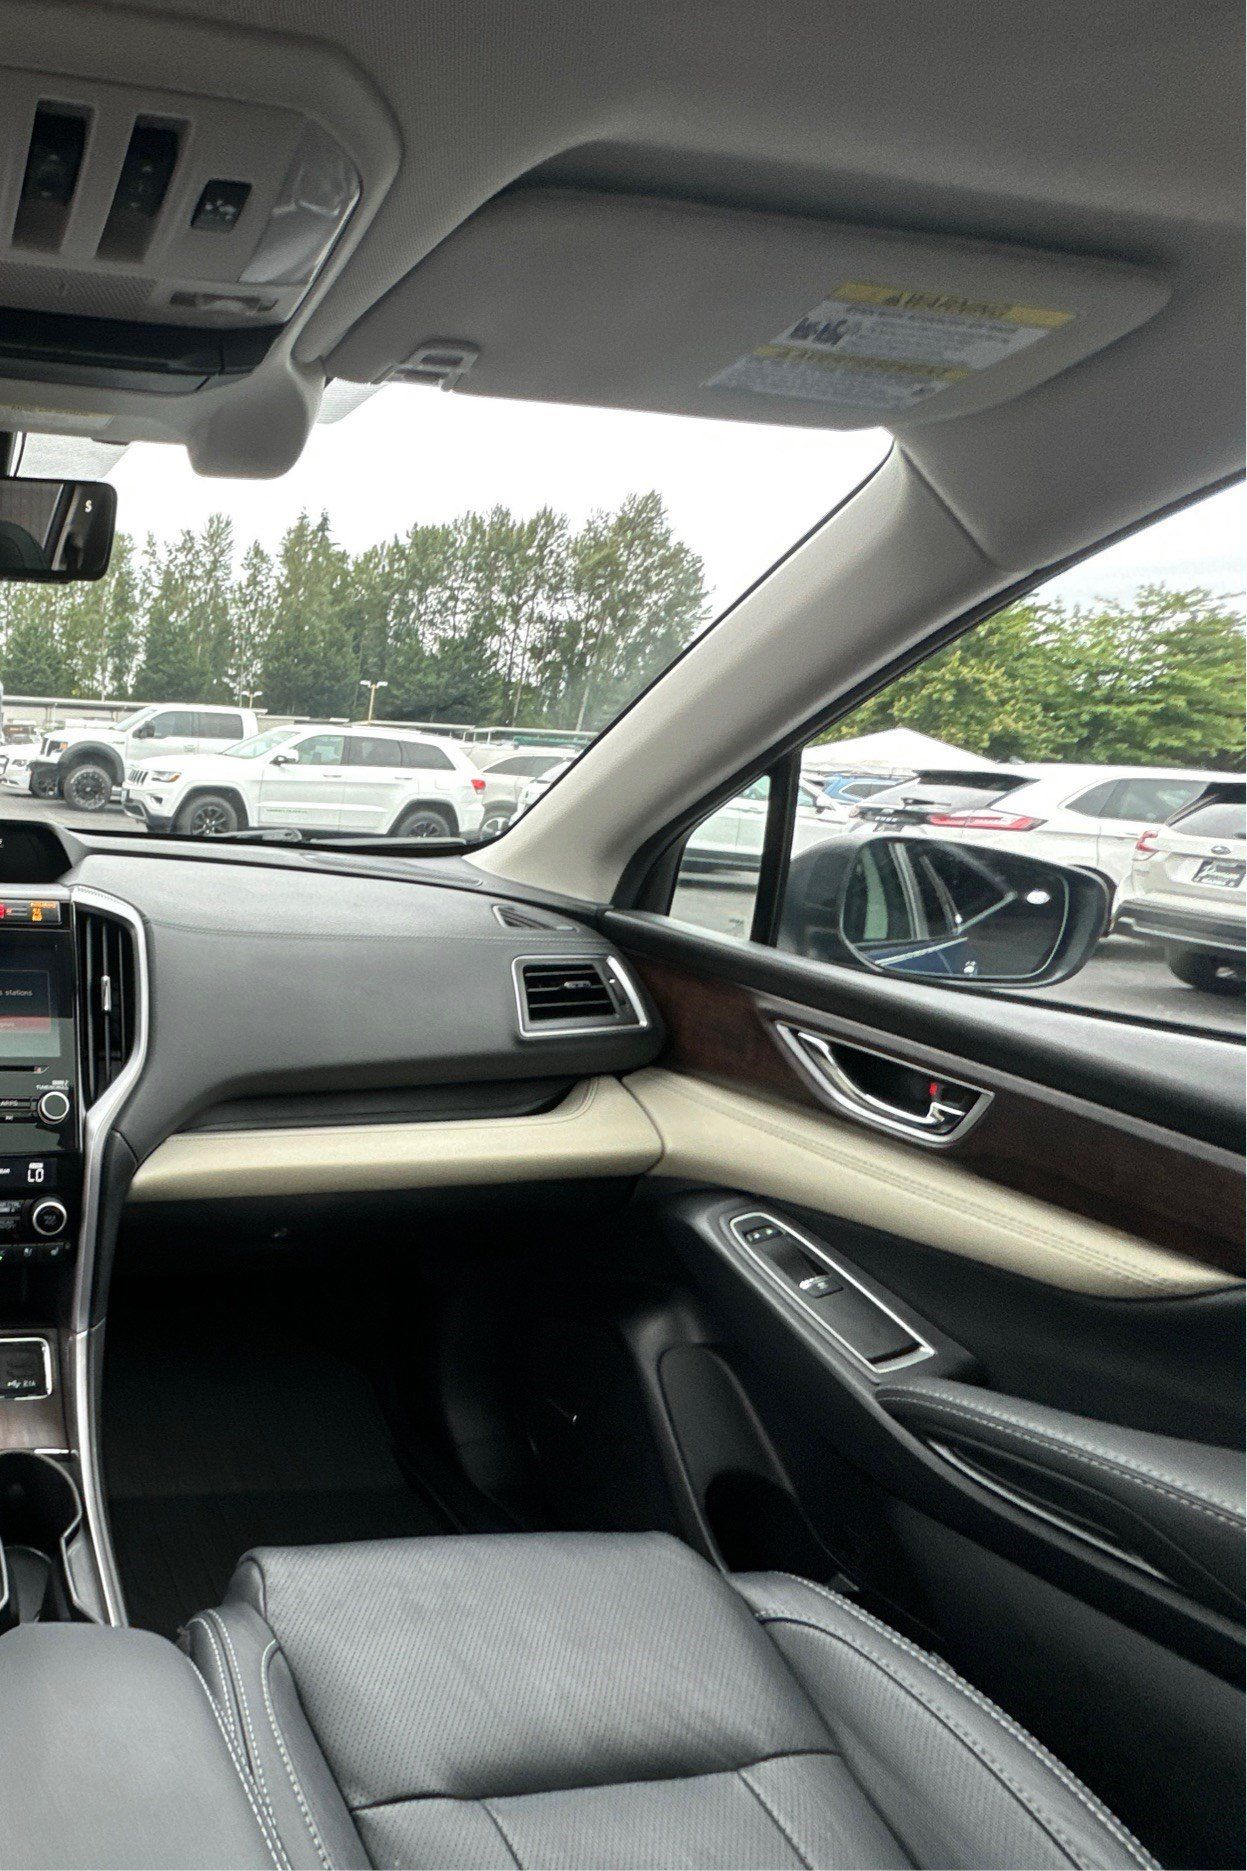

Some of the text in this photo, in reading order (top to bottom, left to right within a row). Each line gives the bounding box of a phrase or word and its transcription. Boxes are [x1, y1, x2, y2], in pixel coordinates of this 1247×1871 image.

[85, 499, 93, 513] S
[5, 989, 33, 997] stations
[27, 1168, 44, 1183] LO
